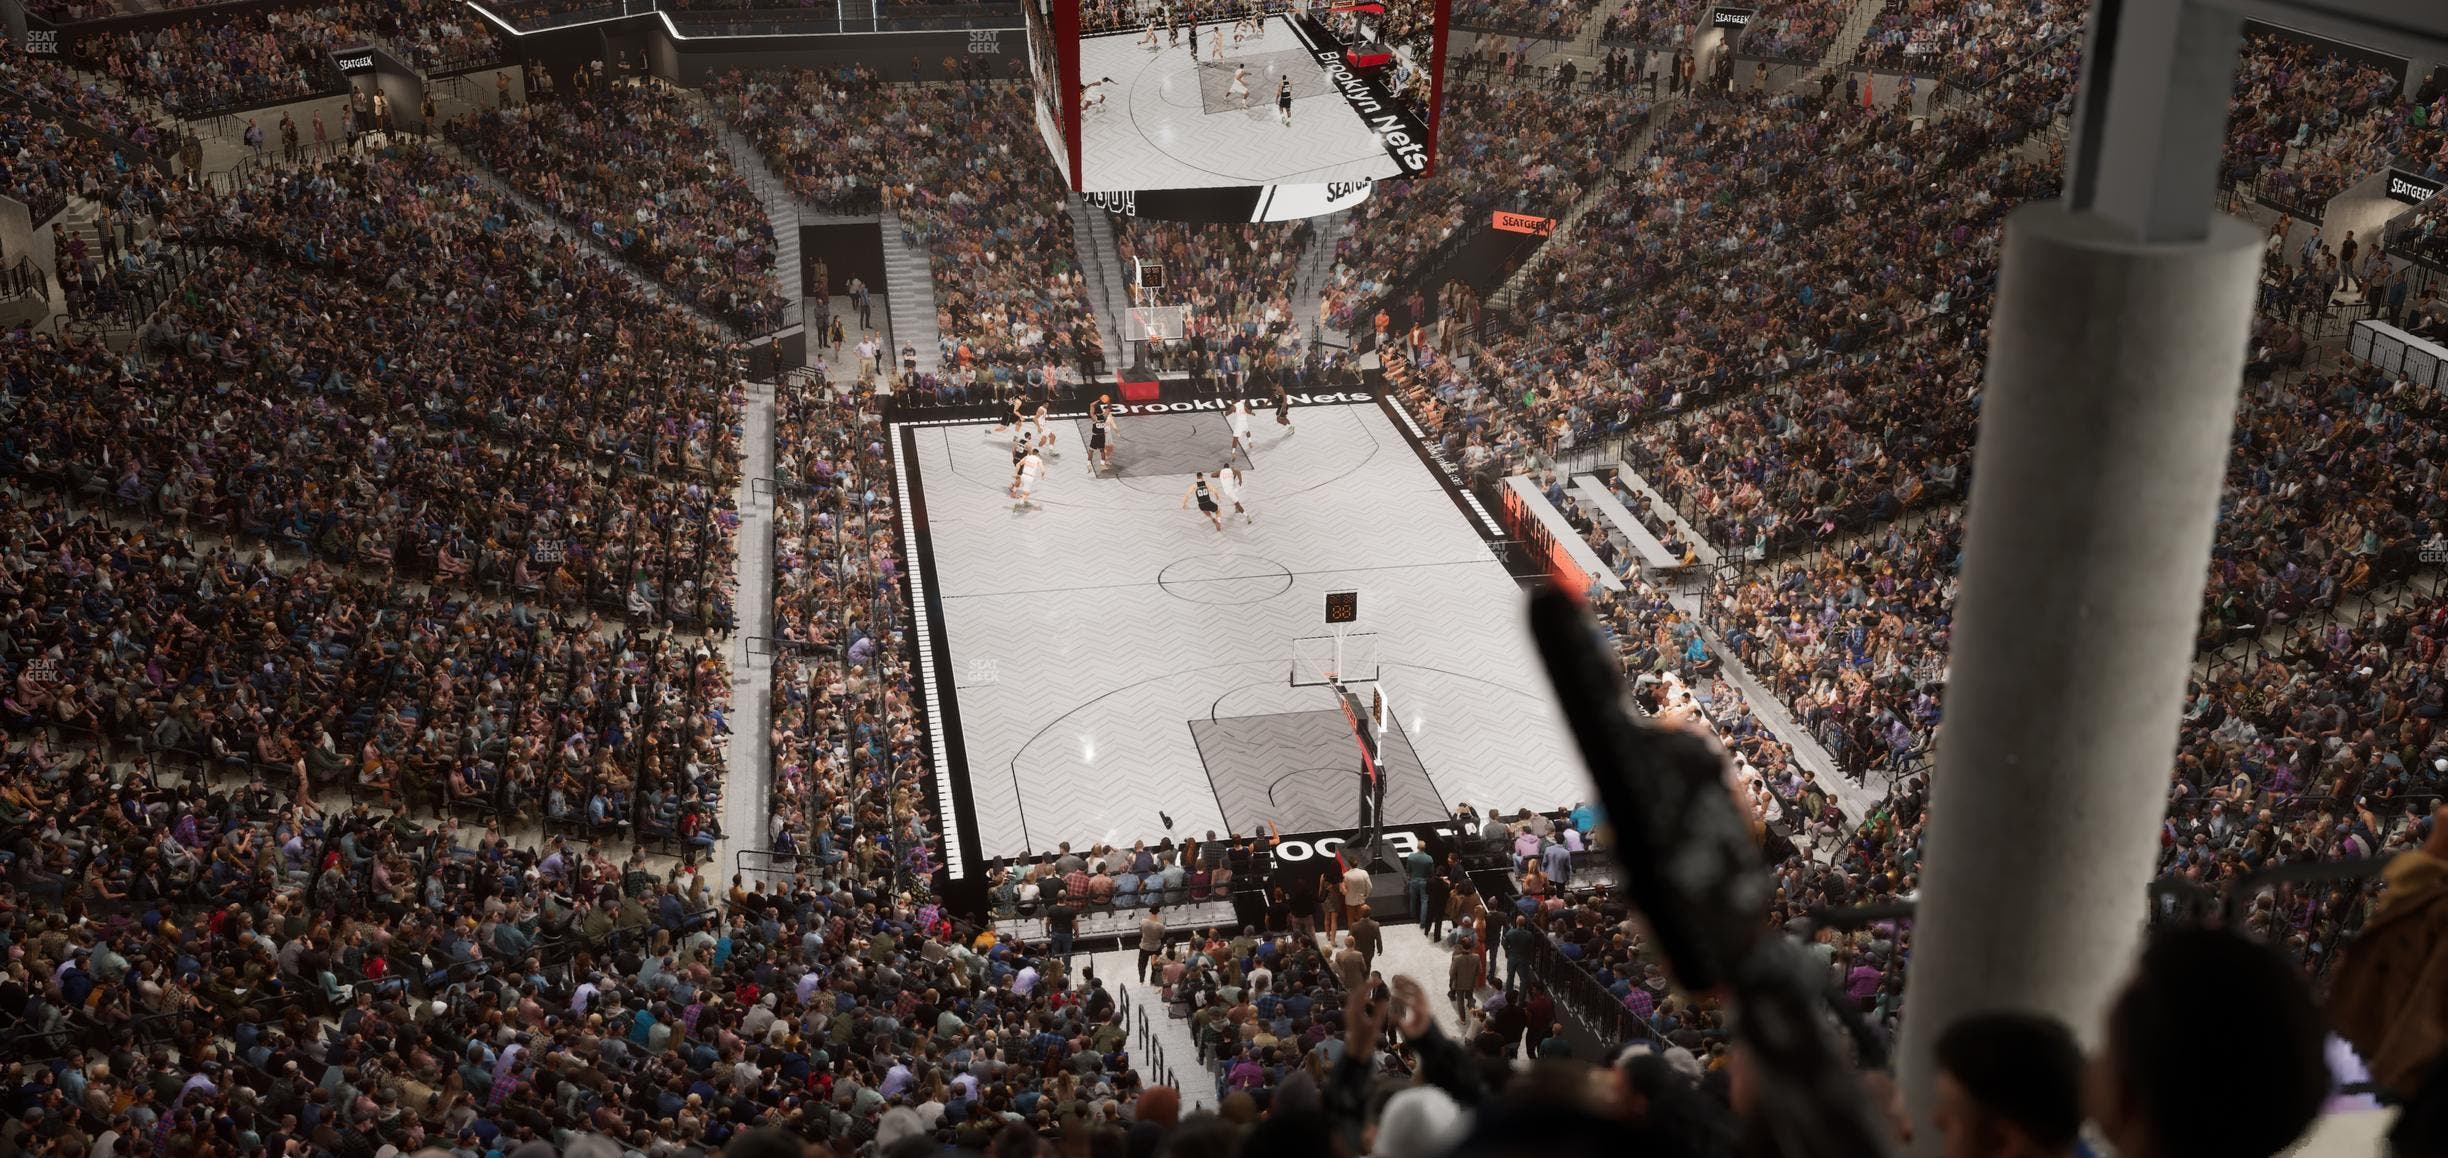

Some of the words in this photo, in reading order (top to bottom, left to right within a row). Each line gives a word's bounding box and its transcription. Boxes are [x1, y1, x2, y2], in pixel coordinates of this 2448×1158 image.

[1715, 12, 1751, 25] SEATGEEK
[339, 55, 374, 71] SEATGEEK
[1319, 50, 1382, 114] Brooklyn
[1371, 114, 1428, 171] Nets
[2390, 177, 2435, 201] SEATGEEK
[1100, 398, 1273, 415] Brookln
[1285, 391, 1374, 405] Nets
